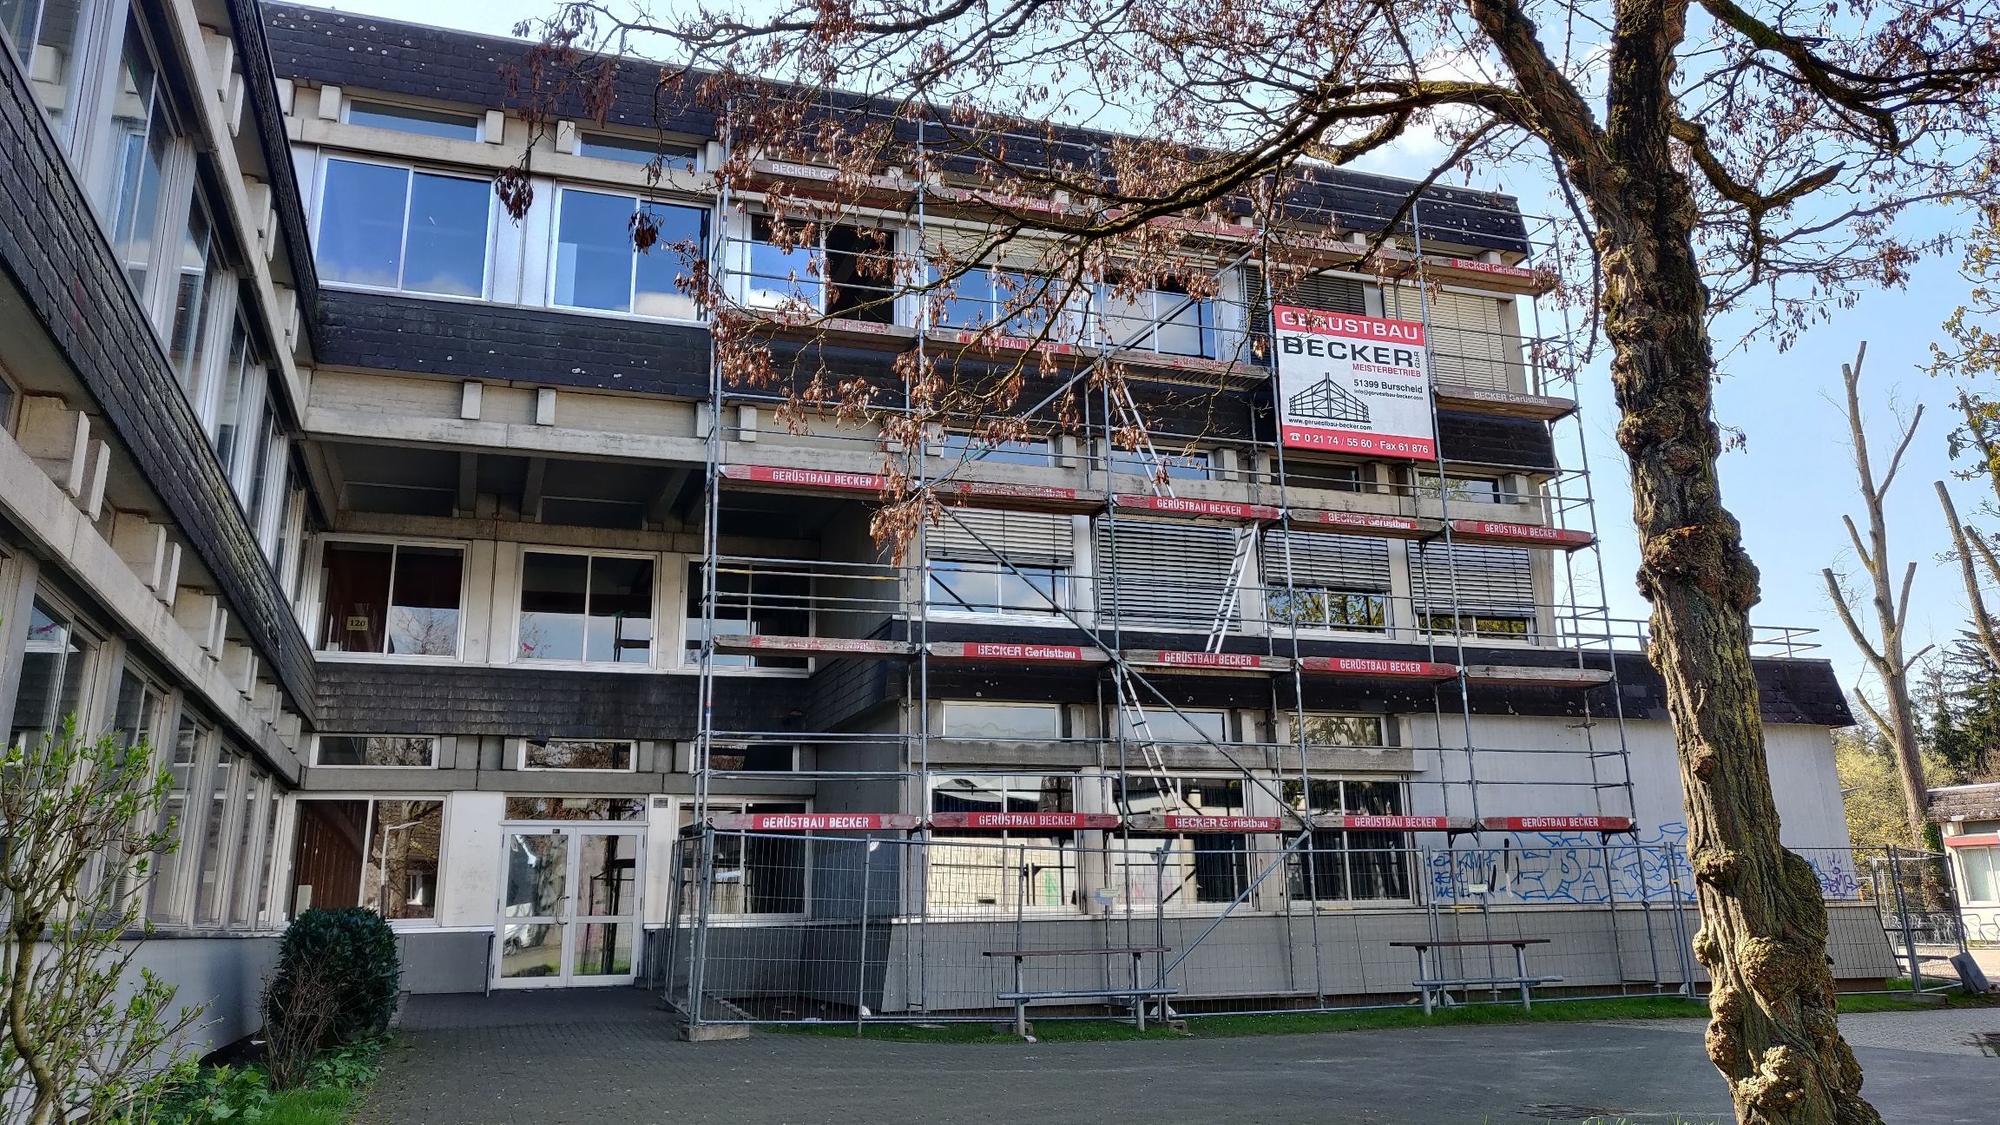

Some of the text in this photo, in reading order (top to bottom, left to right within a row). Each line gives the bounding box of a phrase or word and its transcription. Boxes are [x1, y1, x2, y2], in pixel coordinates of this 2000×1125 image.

[772, 163, 816, 177] BECKER
[1457, 259, 1530, 277] BECKER Gerüstbau
[1283, 335, 1414, 368] BECKER
[1352, 363, 1422, 378] MEISTERBETRIEB
[1353, 379, 1423, 394] 51399 Burscheid
[1474, 391, 1506, 402] BECKER
[1304, 433, 1311, 443] 0
[1311, 434, 1324, 444] 21
[1327, 435, 1339, 445] 74
[1346, 437, 1359, 447] 55
[1380, 441, 1397, 451] Fax
[1398, 442, 1409, 452] 61
[1412, 443, 1429, 454] 876
[772, 469, 872, 487] GERÜSTBAU BECKER
[1157, 498, 1242, 515] GERÜSTBAU BECKER
[1328, 512, 1365, 526] BECKER
[1484, 522, 1558, 538] GERÜSTBAU BECKER
[977, 644, 1076, 659] BECKER Gerüstbau
[1164, 651, 1252, 666] GERÜSTBAU BECKER
[1340, 658, 1421, 673] GERÜSTBAU BECKER
[762, 815, 870, 829] GERÜSTBAU BECKER
[978, 813, 1077, 826] GERÜSTBAU BECKER
[1175, 818, 1268, 829] BECKER Gerüstbau
[1354, 816, 1437, 828] GERÜSTBAU BECKER
[1521, 816, 1599, 828] GERÜSTBAU BECKER
